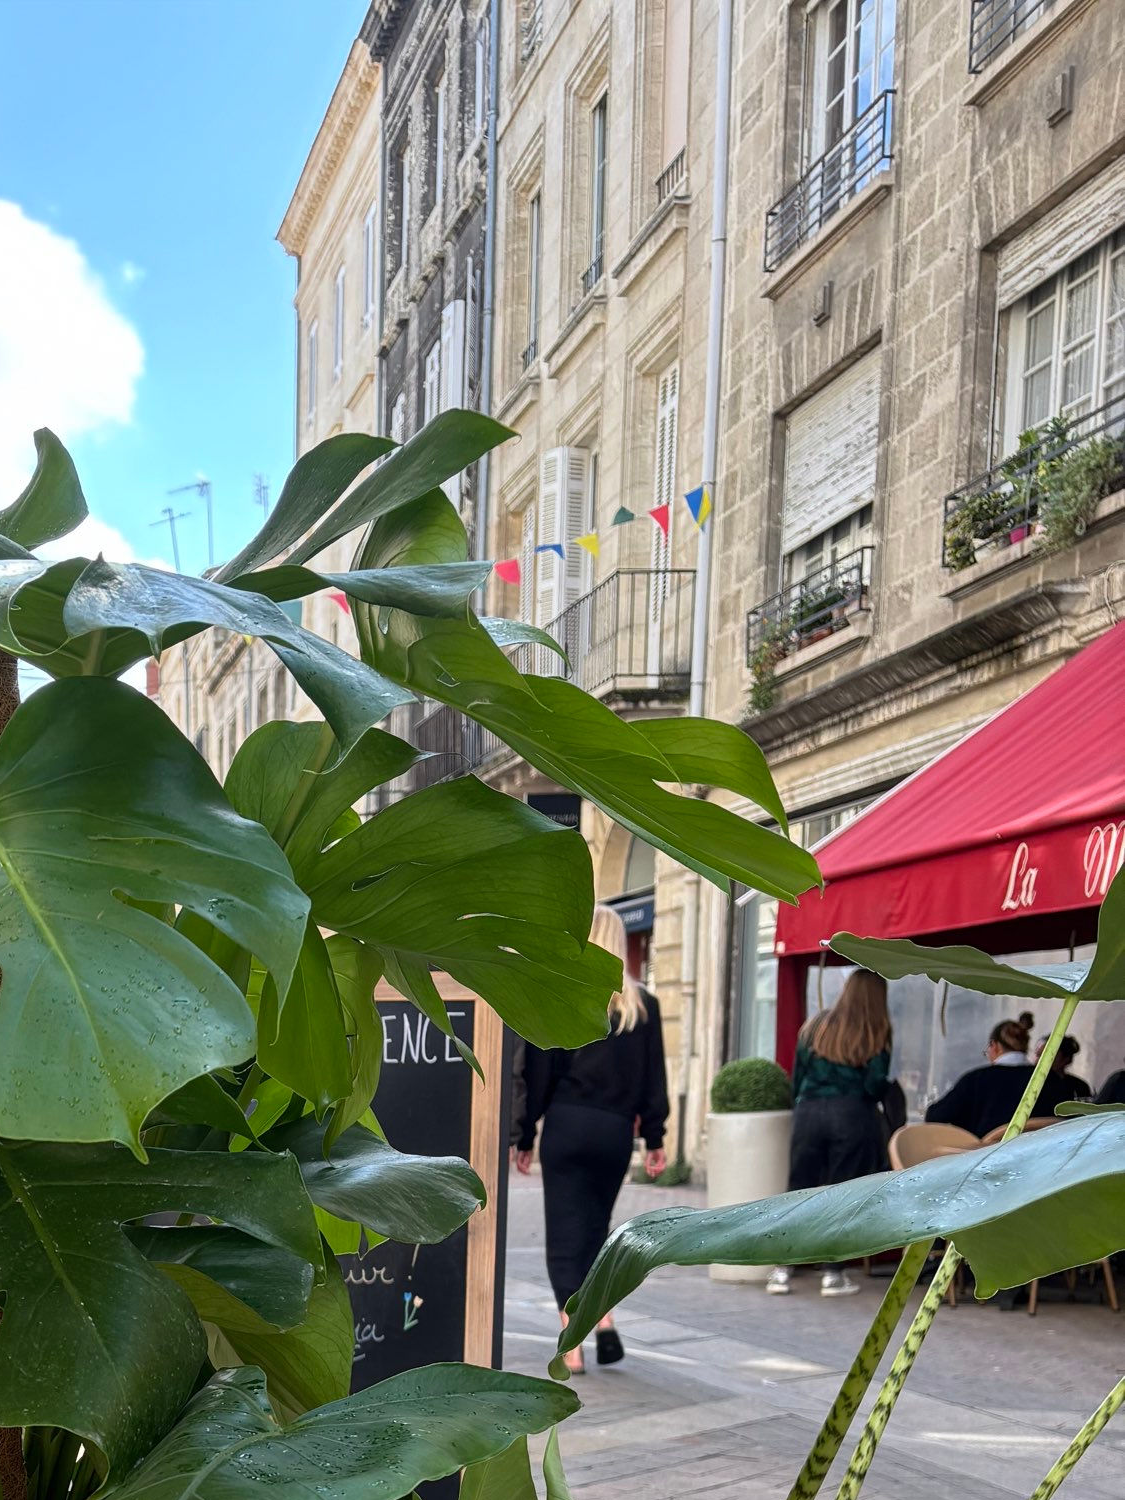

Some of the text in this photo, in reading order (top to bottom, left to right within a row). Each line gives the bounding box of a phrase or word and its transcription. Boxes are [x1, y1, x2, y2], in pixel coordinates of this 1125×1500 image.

[1001, 820, 1125, 911] La M
[381, 1011, 466, 1064] ENCE
